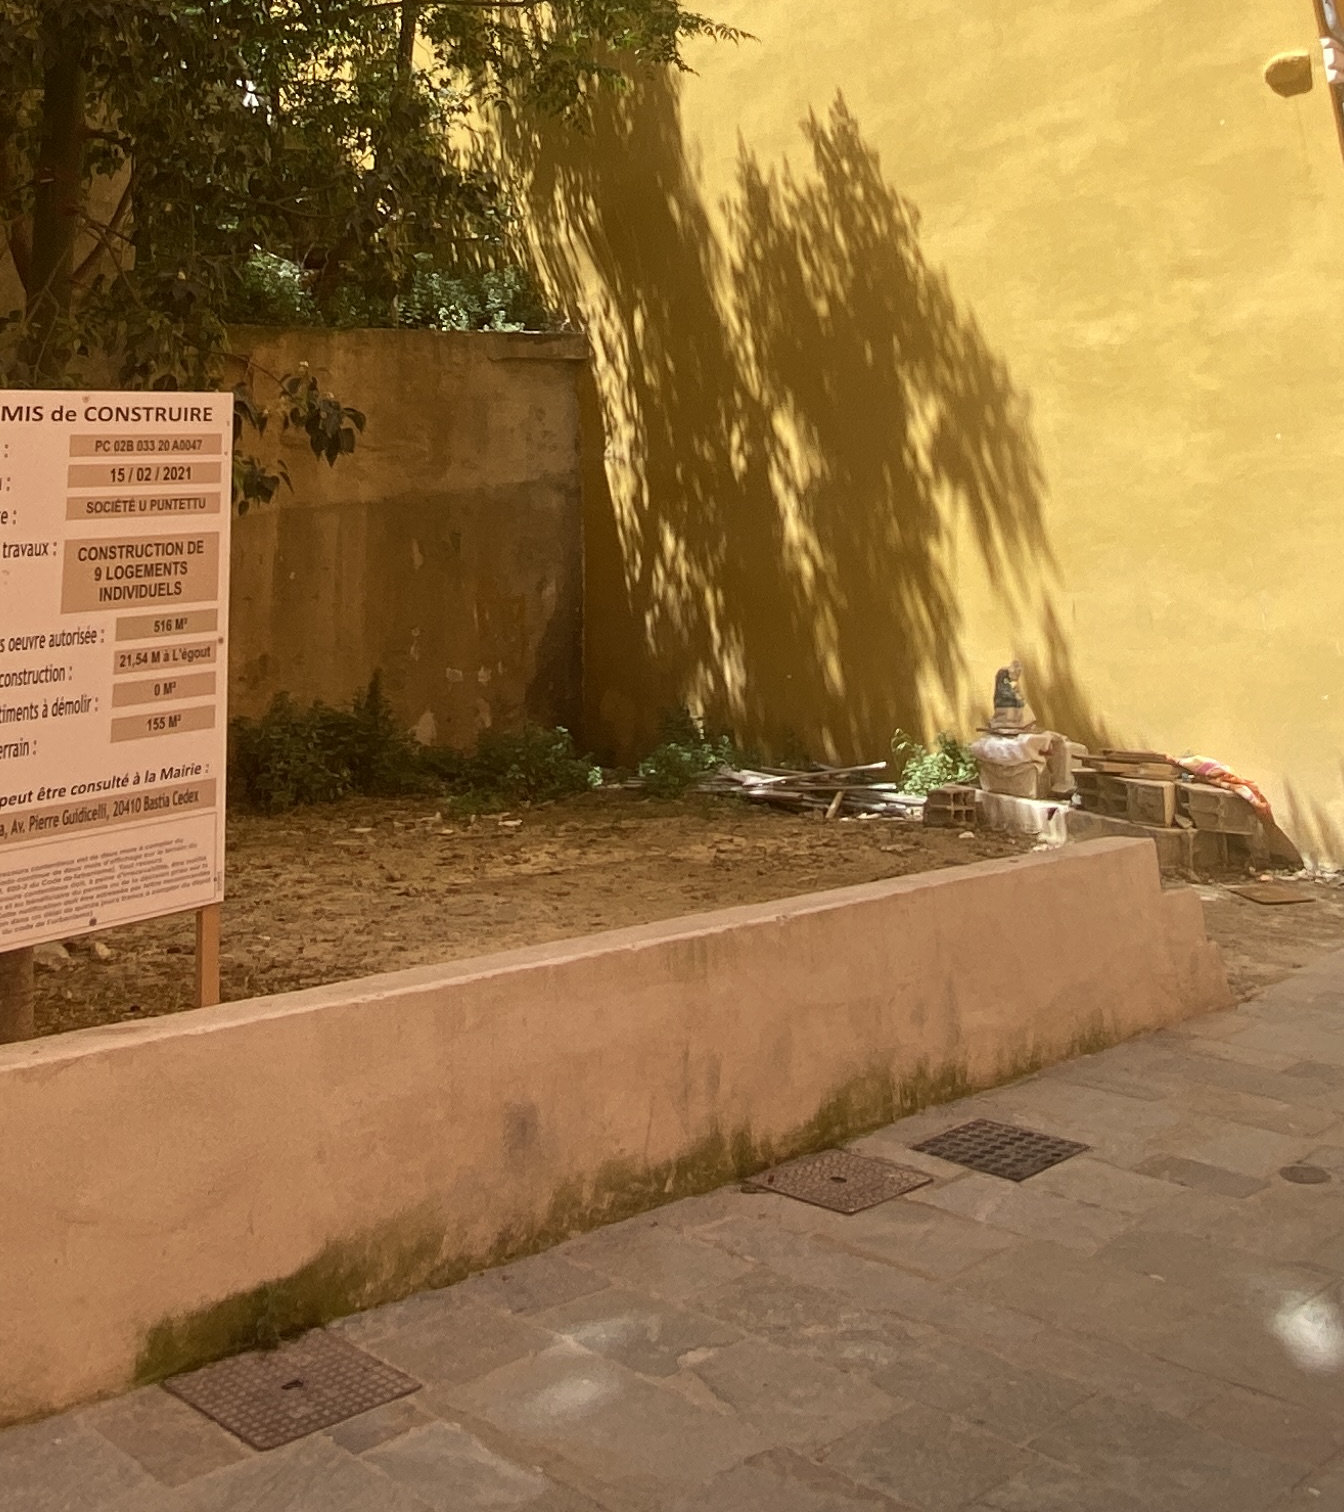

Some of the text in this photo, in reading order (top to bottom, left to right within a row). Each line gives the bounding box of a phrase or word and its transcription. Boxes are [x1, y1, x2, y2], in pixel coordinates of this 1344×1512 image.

[51, 405, 77, 422] de
[83, 406, 213, 422] CONSTRUIRE
[94, 439, 203, 452] PC 02B 033 20 A0047
[110, 468, 125, 483] 15
[136, 467, 152, 482] 02
[162, 466, 192, 481] 2021
[149, 497, 206, 511] PUNTETTU
[2, 542, 49, 559] travaux
[77, 540, 205, 562] CONSTRUCTION DE
[94, 561, 188, 581] 9 LOGEMENTS
[99, 581, 182, 602] INDIVIDUELS
[153, 619, 172, 633] 516
[8, 634, 46, 652] oeuvre
[48, 626, 97, 648] autorisée
[119, 652, 148, 668] 21,54
[151, 651, 161, 663] M
[42, 698, 48, 719] à
[51, 694, 92, 717] démolir
[146, 717, 165, 731] 155
[37, 786, 67, 801] être
[70, 772, 129, 796] consulté
[132, 772, 141, 786] à
[144, 770, 156, 784] la
[160, 762, 202, 780] Mairie
[28, 814, 60, 832] Pierre
[112, 797, 142, 817] 20410
[143, 791, 170, 811] Bastia
[172, 788, 199, 806] Cedex
